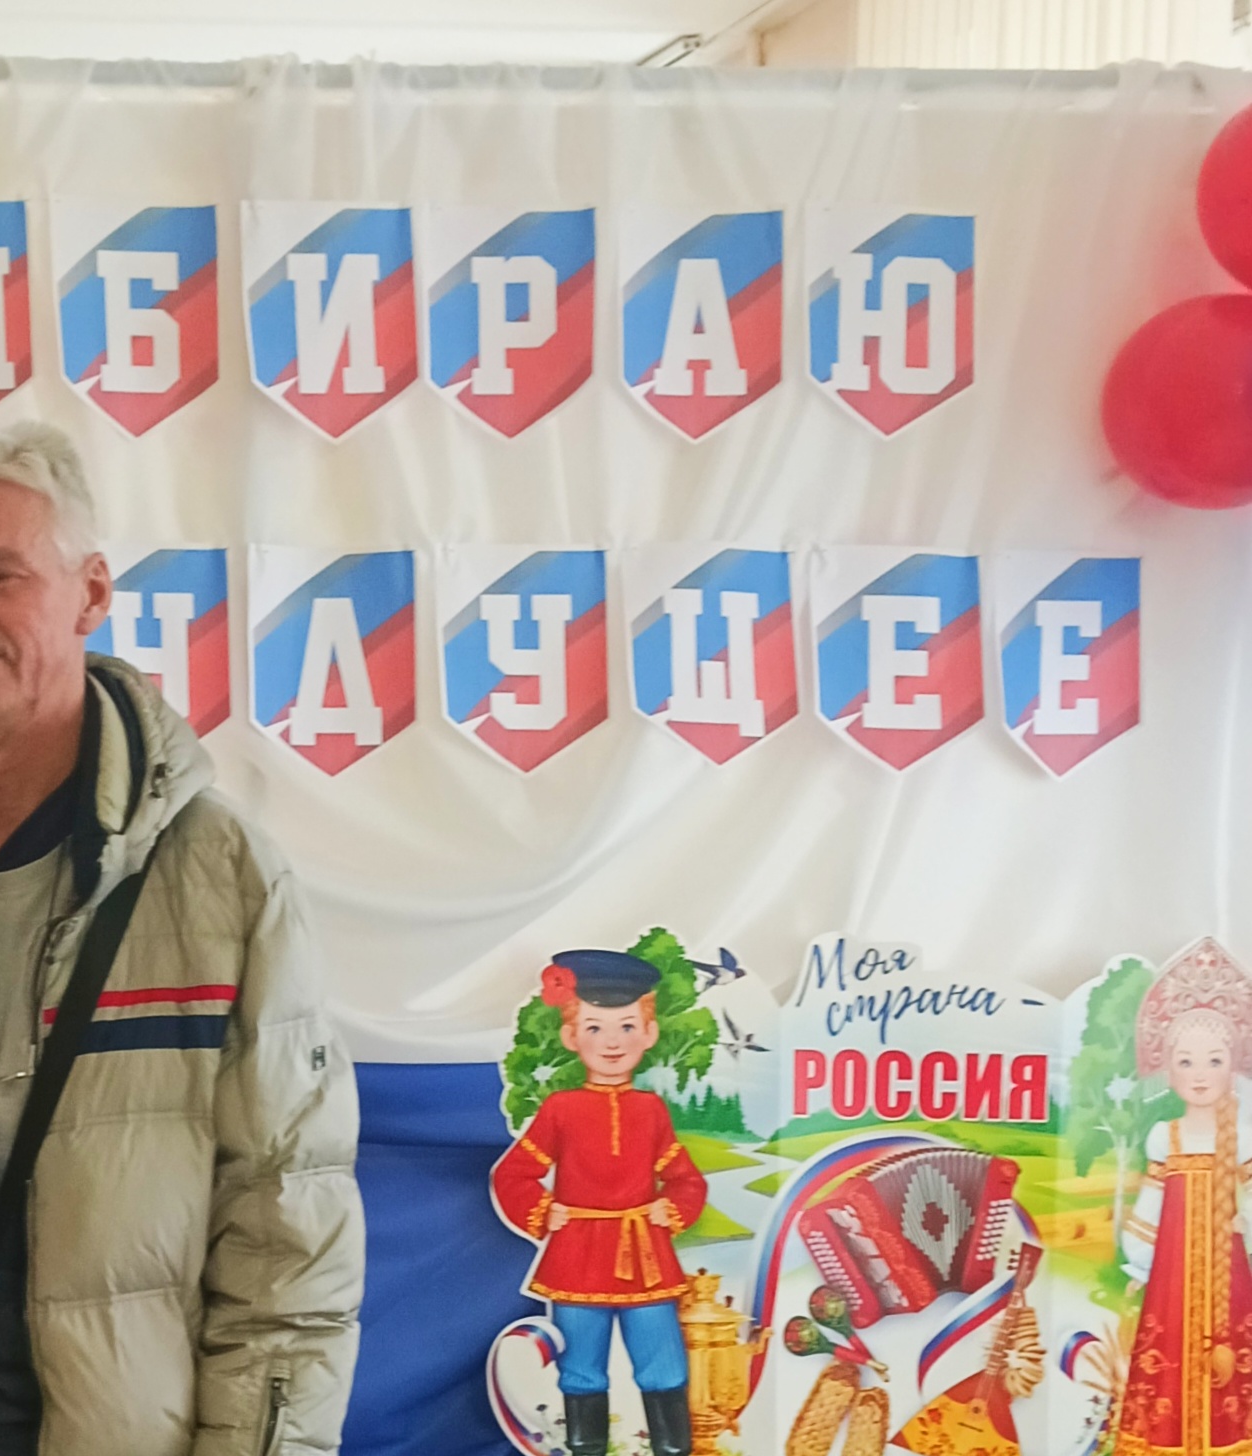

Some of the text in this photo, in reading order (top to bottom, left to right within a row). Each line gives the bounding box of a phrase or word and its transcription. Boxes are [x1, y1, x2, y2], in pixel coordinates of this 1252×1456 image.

[795, 938, 916, 1008] Моя
[826, 982, 1007, 1045] страна
[792, 1048, 1048, 1122] РОССИЯ
